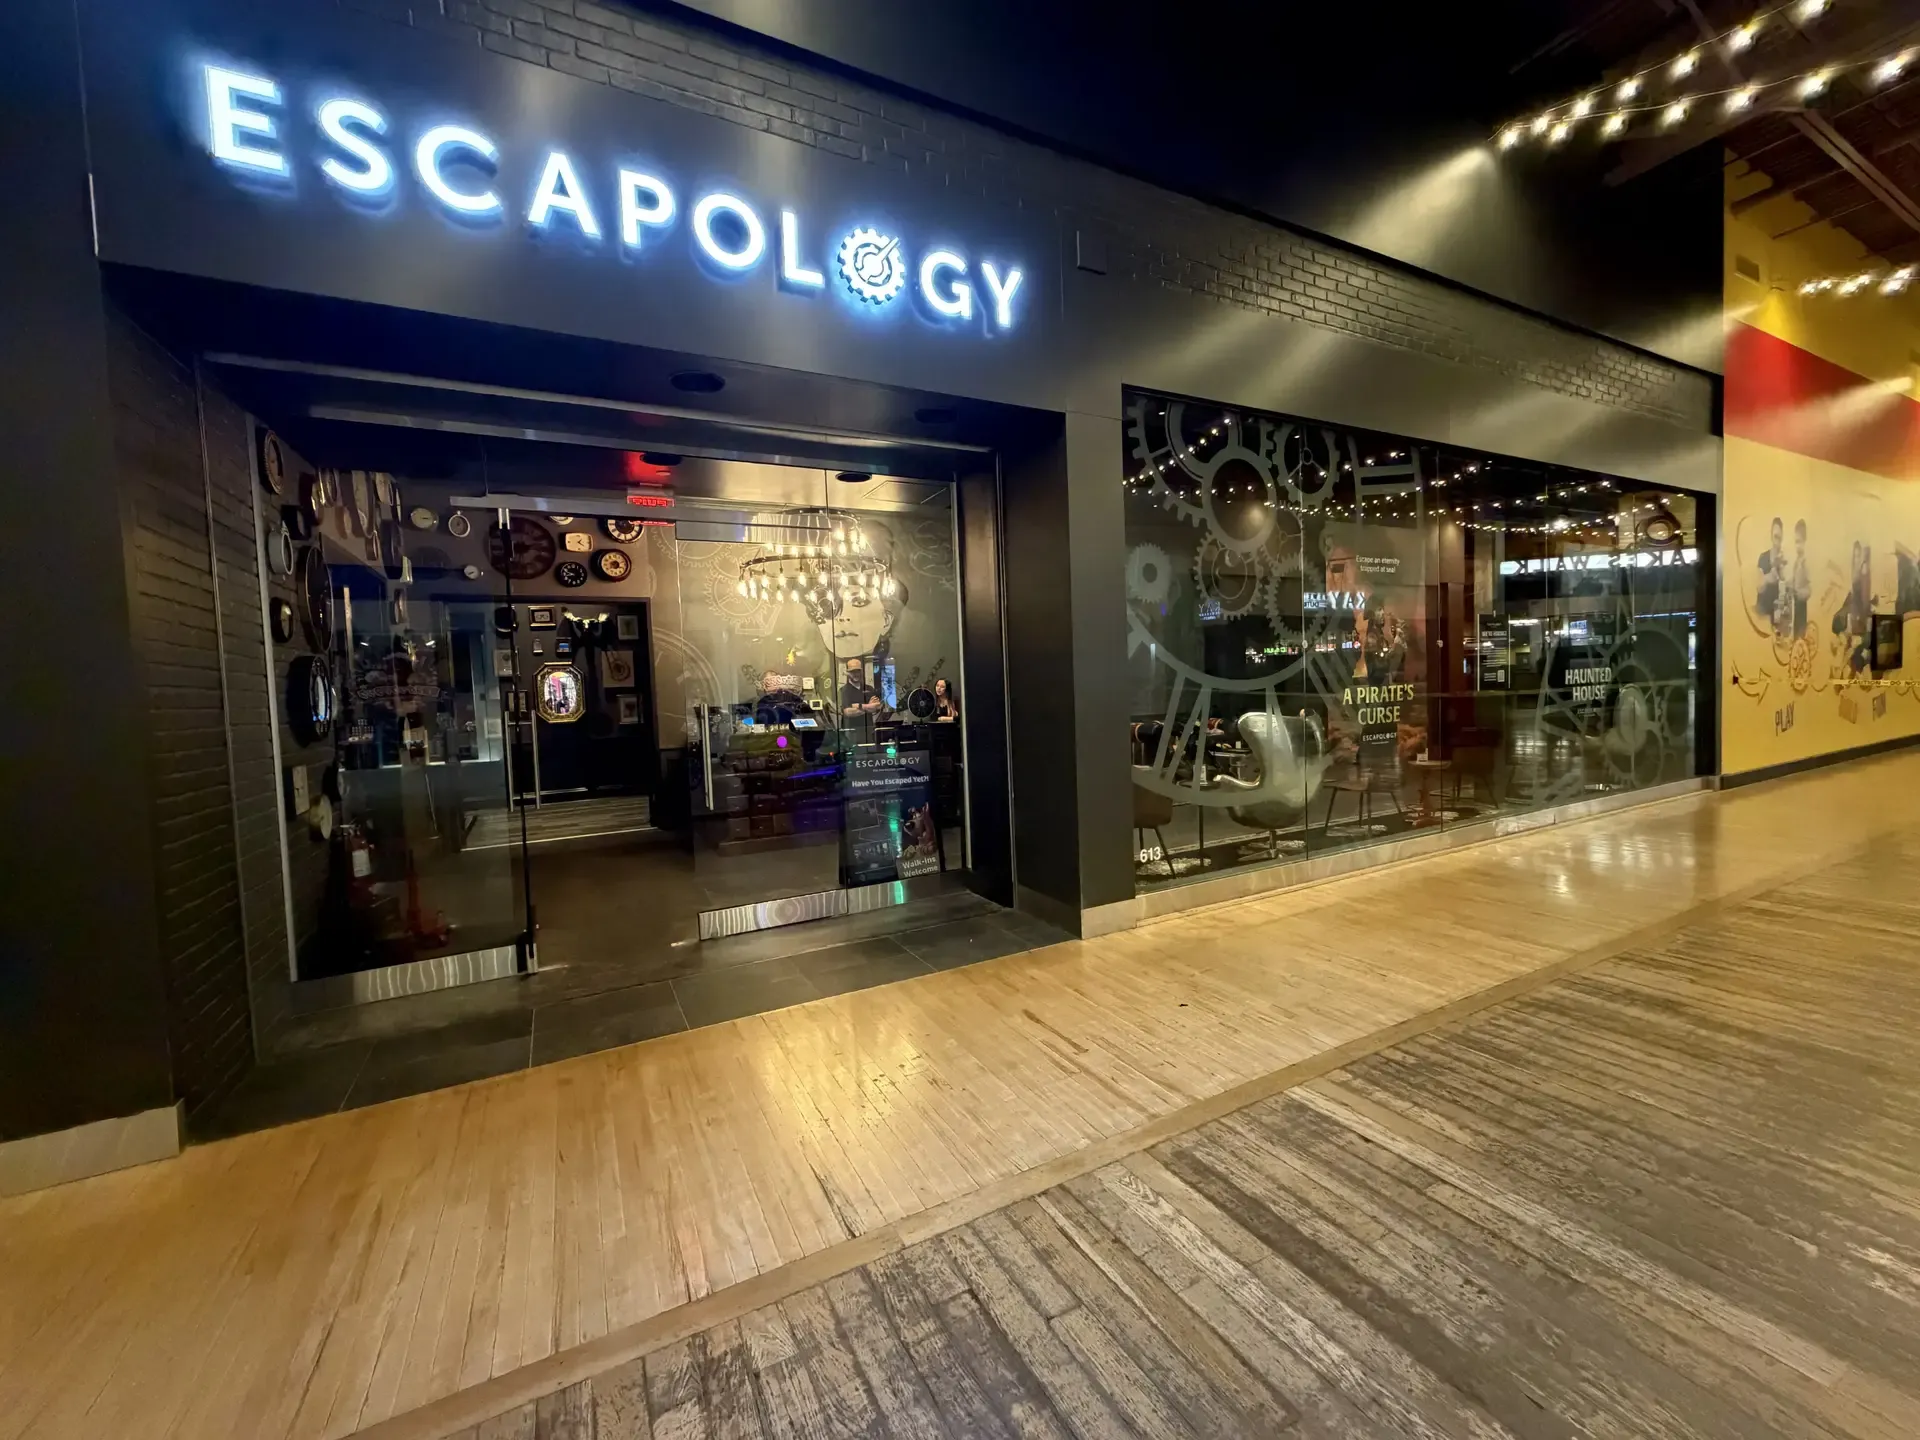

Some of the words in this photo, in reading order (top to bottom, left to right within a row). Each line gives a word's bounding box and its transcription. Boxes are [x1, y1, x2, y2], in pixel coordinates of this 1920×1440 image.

[203, 64, 1024, 328] ESCAPOLOGY
[1356, 555, 1373, 564] Escape
[1382, 557, 1400, 566] eternity
[1360, 565, 1379, 573] trapped
[1565, 667, 1612, 685] HAUNTED
[1342, 686, 1353, 705] A
[1357, 683, 1414, 704] PIRATE'S
[1573, 685, 1606, 702] HOUSE
[1358, 705, 1401, 725] CURSE
[1775, 700, 1795, 737] PLAY
[1362, 733, 1397, 741] ESCAPOLOGY
[855, 757, 920, 768] ESCAPOLOGY
[885, 776, 912, 785] Escaped
[1140, 846, 1161, 863] 613
[902, 856, 936, 869] Walk-Ins
[903, 865, 938, 878] Welcome
